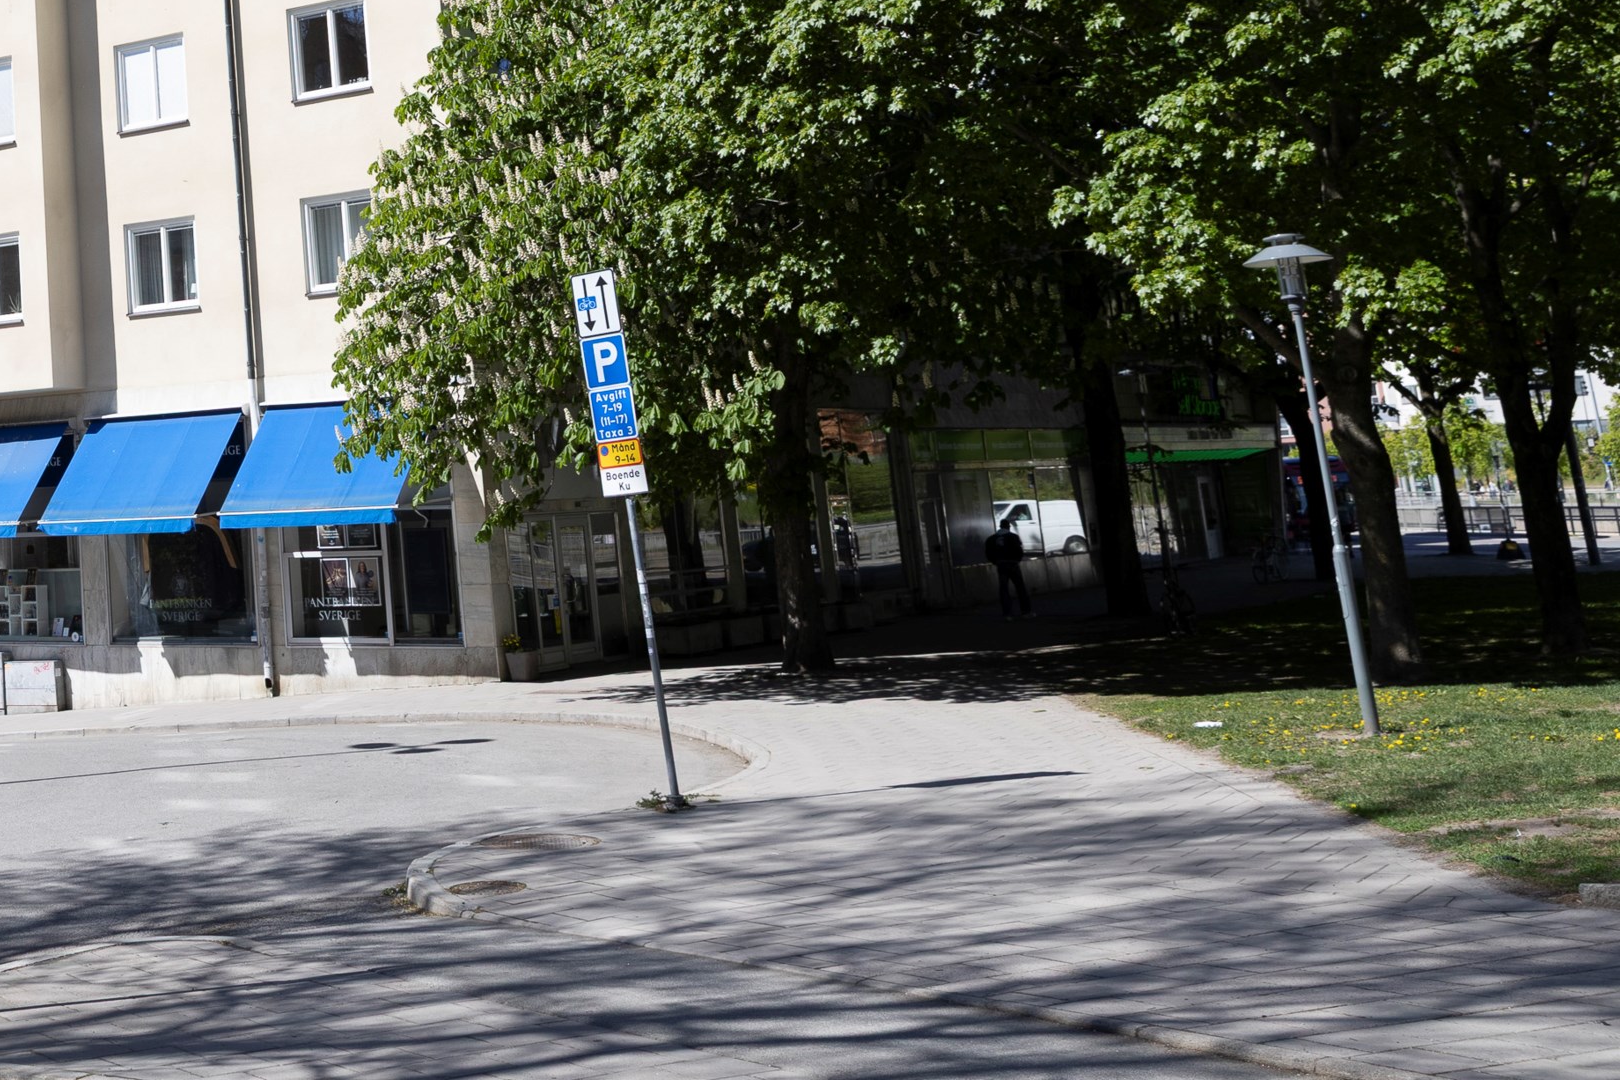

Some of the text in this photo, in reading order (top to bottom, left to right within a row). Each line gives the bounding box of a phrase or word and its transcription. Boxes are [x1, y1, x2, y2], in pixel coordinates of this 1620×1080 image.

[592, 340, 619, 383] P
[595, 389, 627, 403] Avgift
[601, 402, 623, 414] 7-19
[600, 413, 628, 427] (11-17)
[599, 426, 634, 439] Taxa 3
[611, 442, 636, 453] Månd
[614, 453, 636, 464] 9-14
[606, 470, 641, 481] Boende
[619, 482, 631, 491] Ku
[149, 597, 212, 609] PANTBANKEN
[162, 610, 201, 622] SVERIGE
[318, 609, 362, 621] SVERIGE
